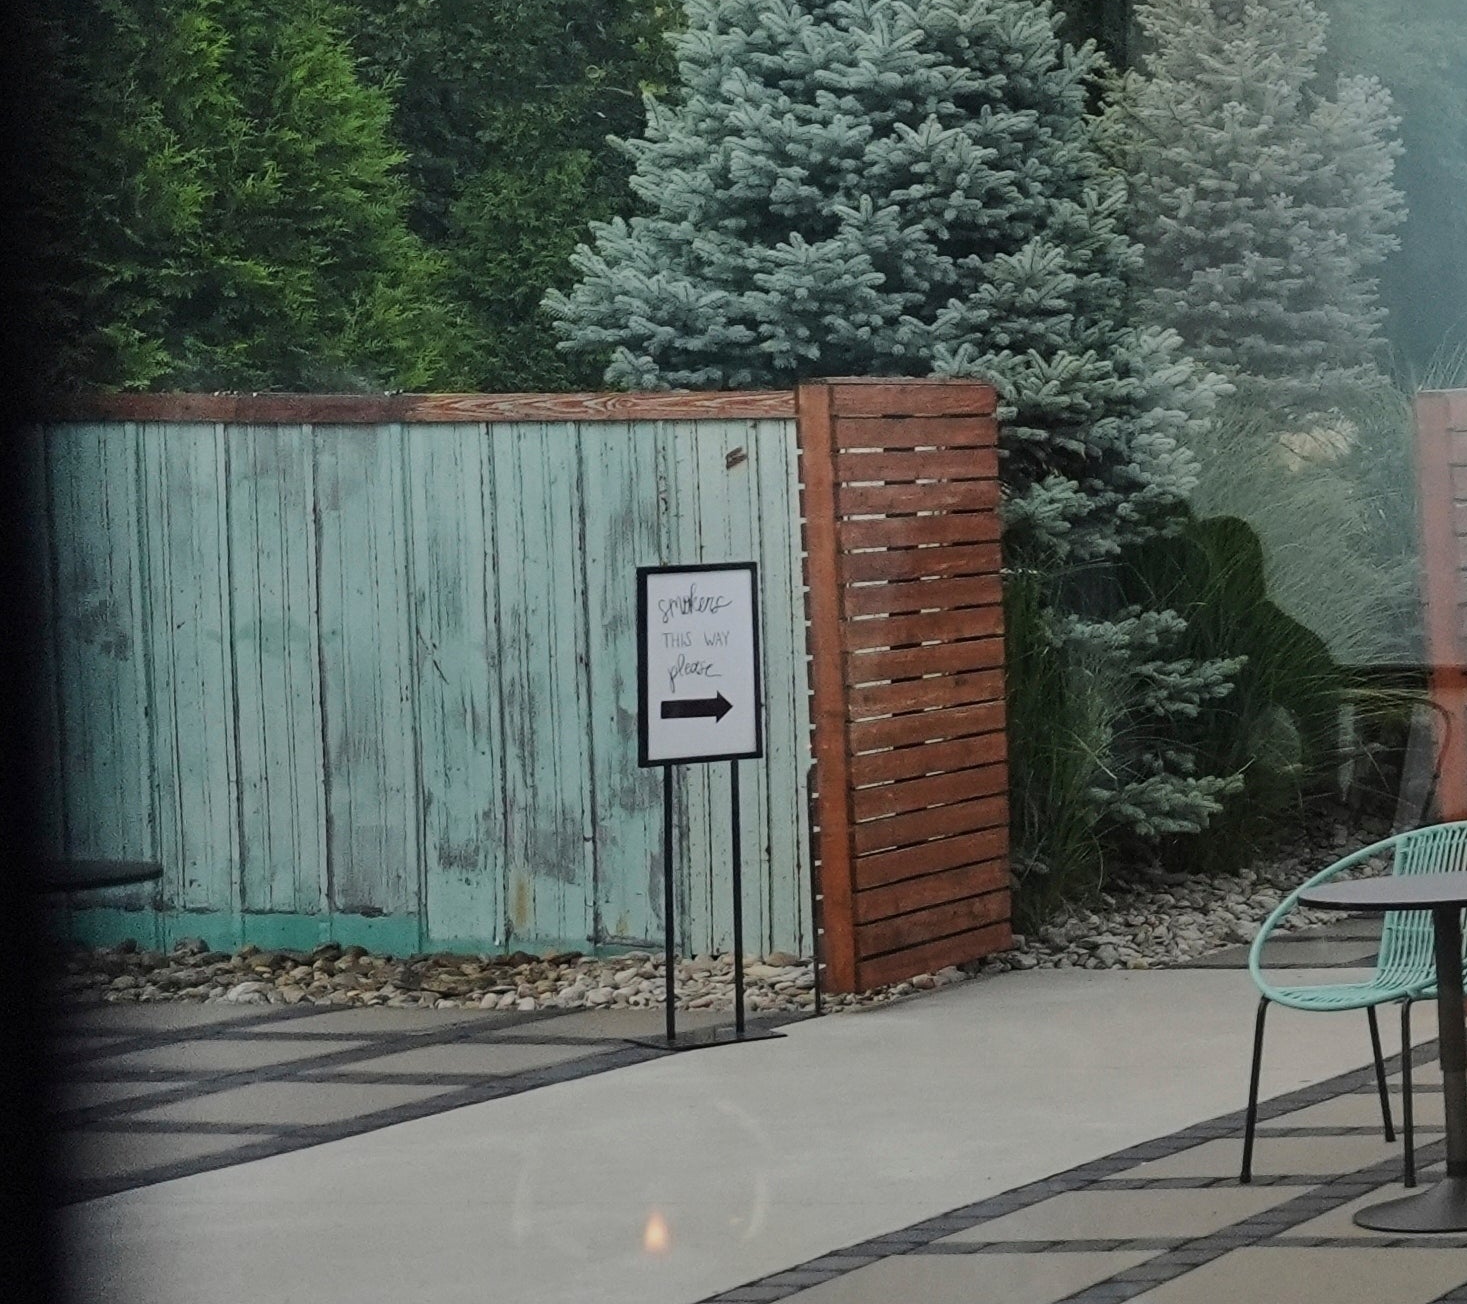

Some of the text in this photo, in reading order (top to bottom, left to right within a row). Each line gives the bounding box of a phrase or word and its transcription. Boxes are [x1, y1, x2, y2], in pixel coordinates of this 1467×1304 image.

[663, 630, 730, 648] THIS WAY
[669, 654, 722, 693] please
